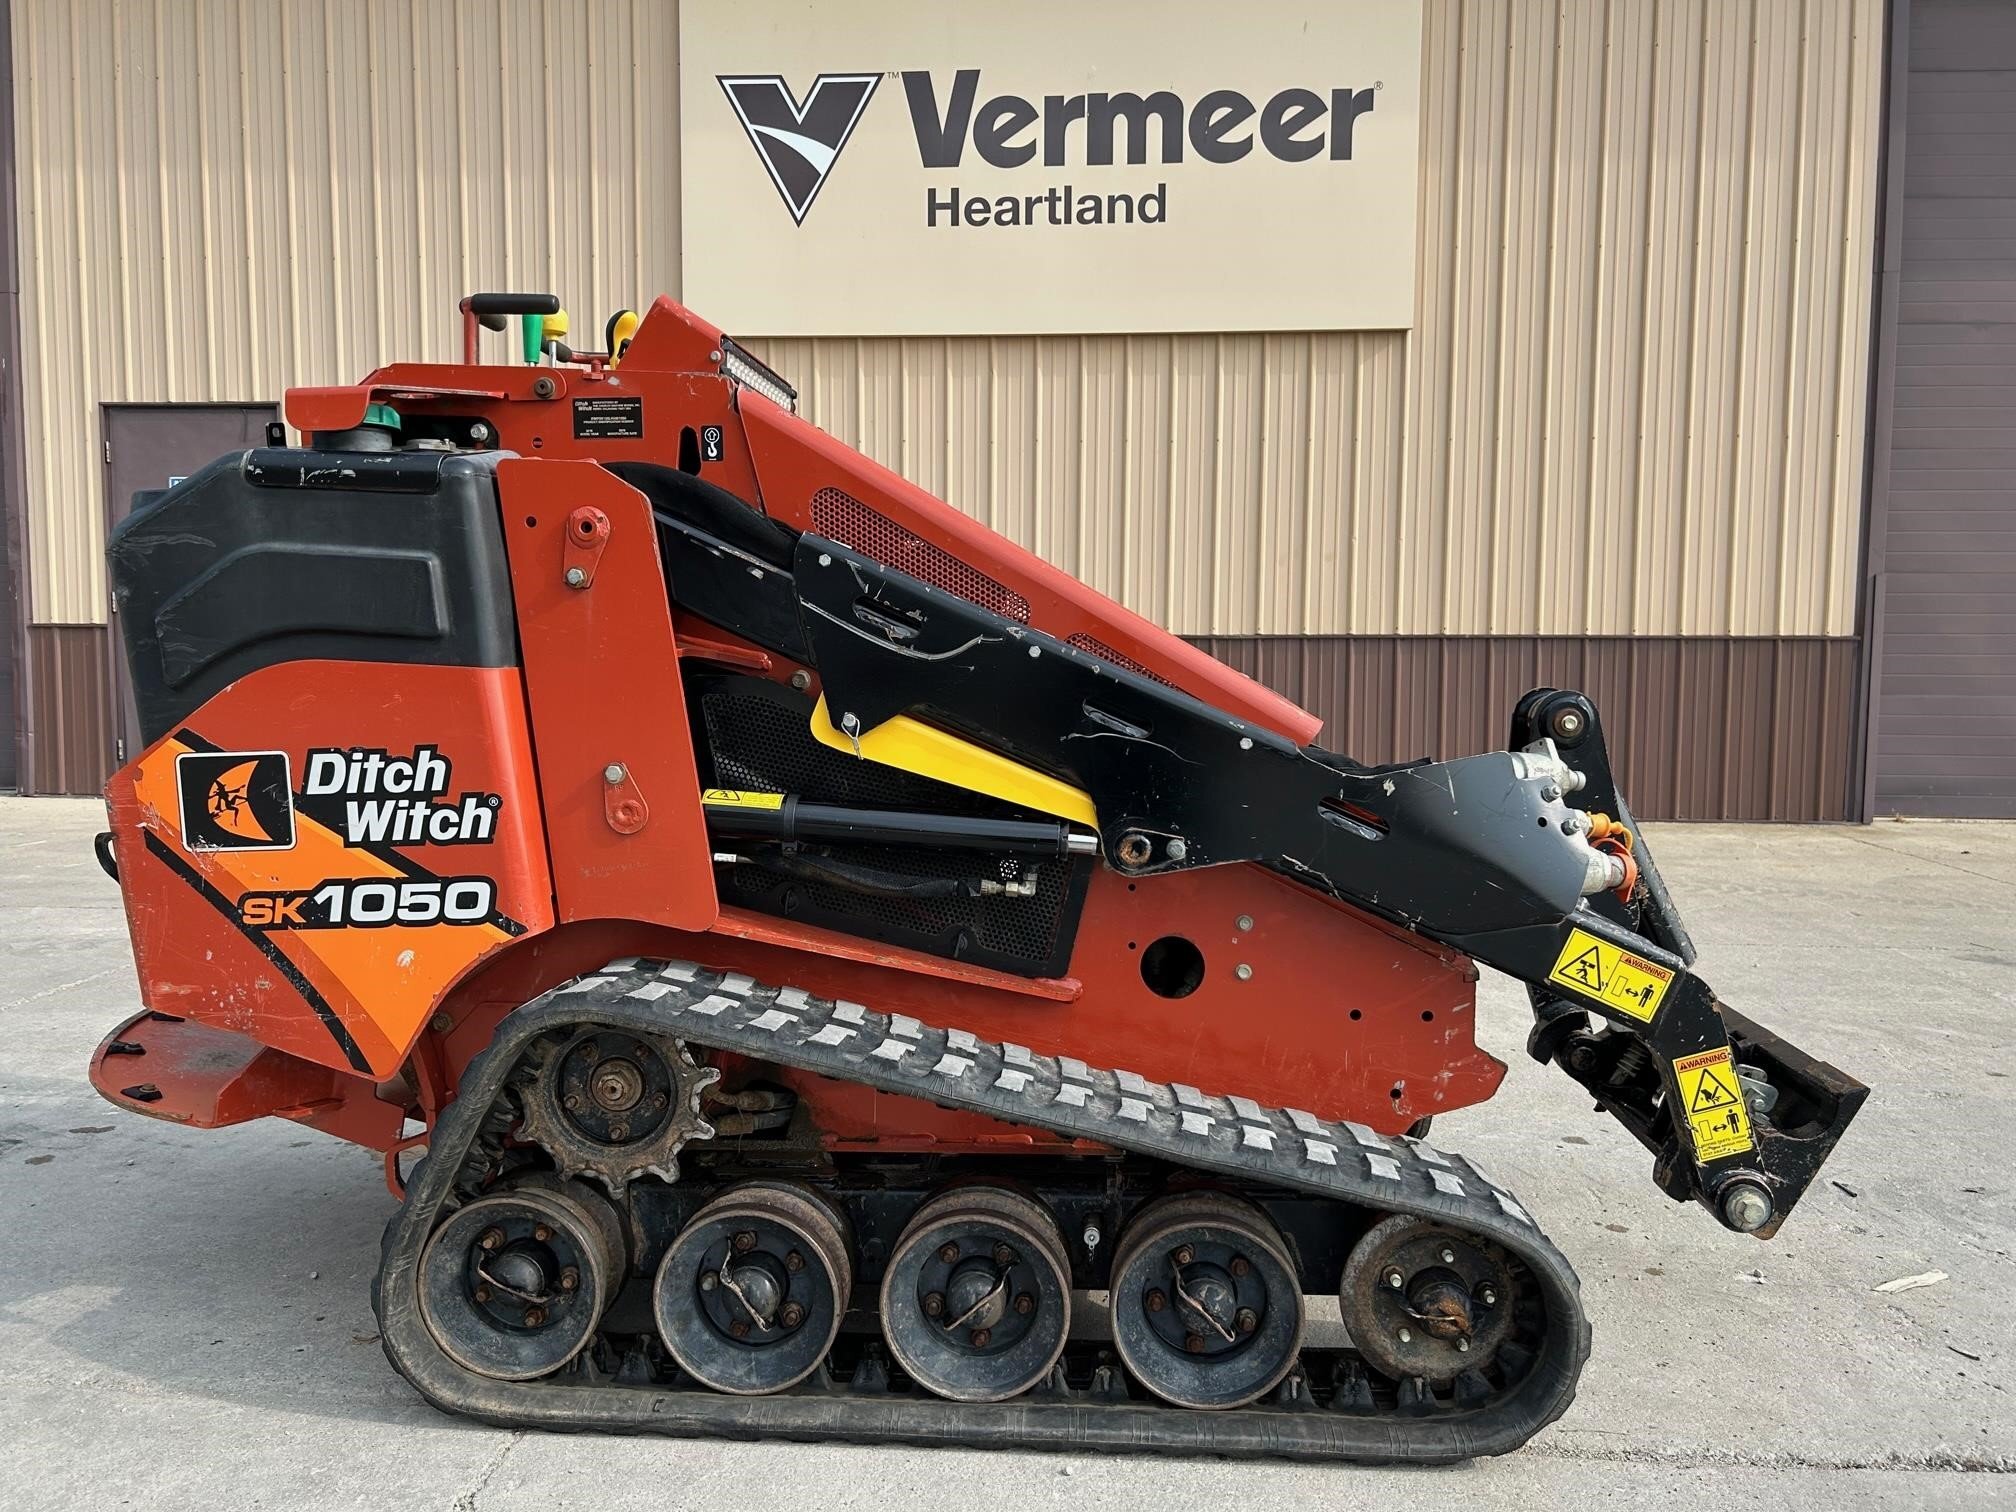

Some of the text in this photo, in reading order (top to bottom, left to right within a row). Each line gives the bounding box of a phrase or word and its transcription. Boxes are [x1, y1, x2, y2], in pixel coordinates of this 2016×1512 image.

[926, 183, 1168, 228] Heartland
[306, 750, 447, 795] Ditch
[1631, 957, 1667, 979] WARNING
[1687, 1052, 1728, 1069] WARNING
